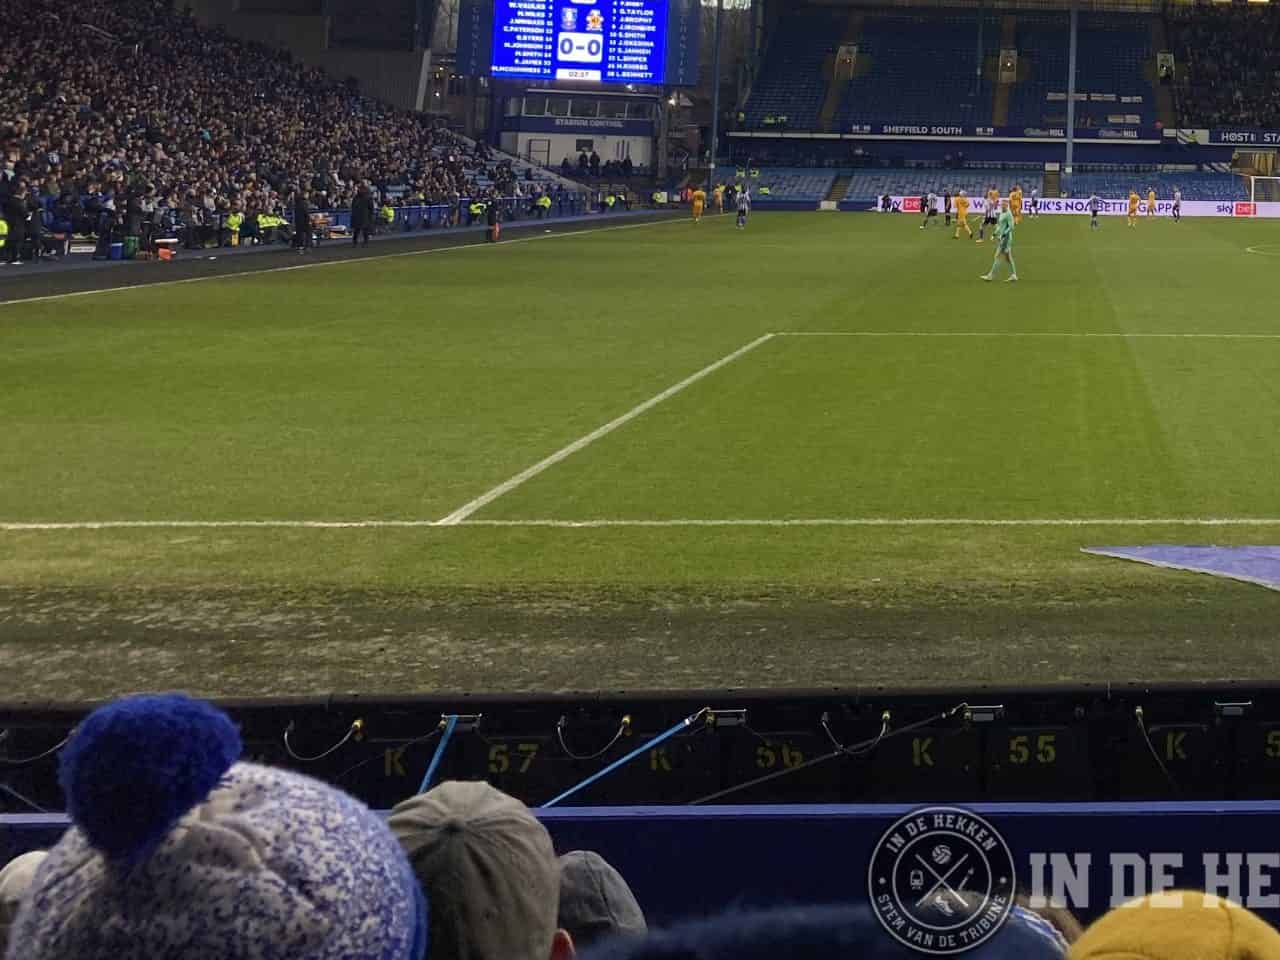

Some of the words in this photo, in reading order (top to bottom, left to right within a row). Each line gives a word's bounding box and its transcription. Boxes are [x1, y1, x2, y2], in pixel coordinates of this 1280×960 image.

[882, 124, 928, 135] SHEFFIELD
[931, 126, 963, 136] SOUTH
[1221, 132, 1248, 142] HOST
[1096, 201, 1146, 213] BETTIG
[1216, 203, 1233, 215] sky
[912, 738, 935, 767] K
[1008, 735, 1057, 764] 55
[1166, 732, 1188, 761] K
[384, 748, 406, 776] K
[488, 744, 538, 774] 57
